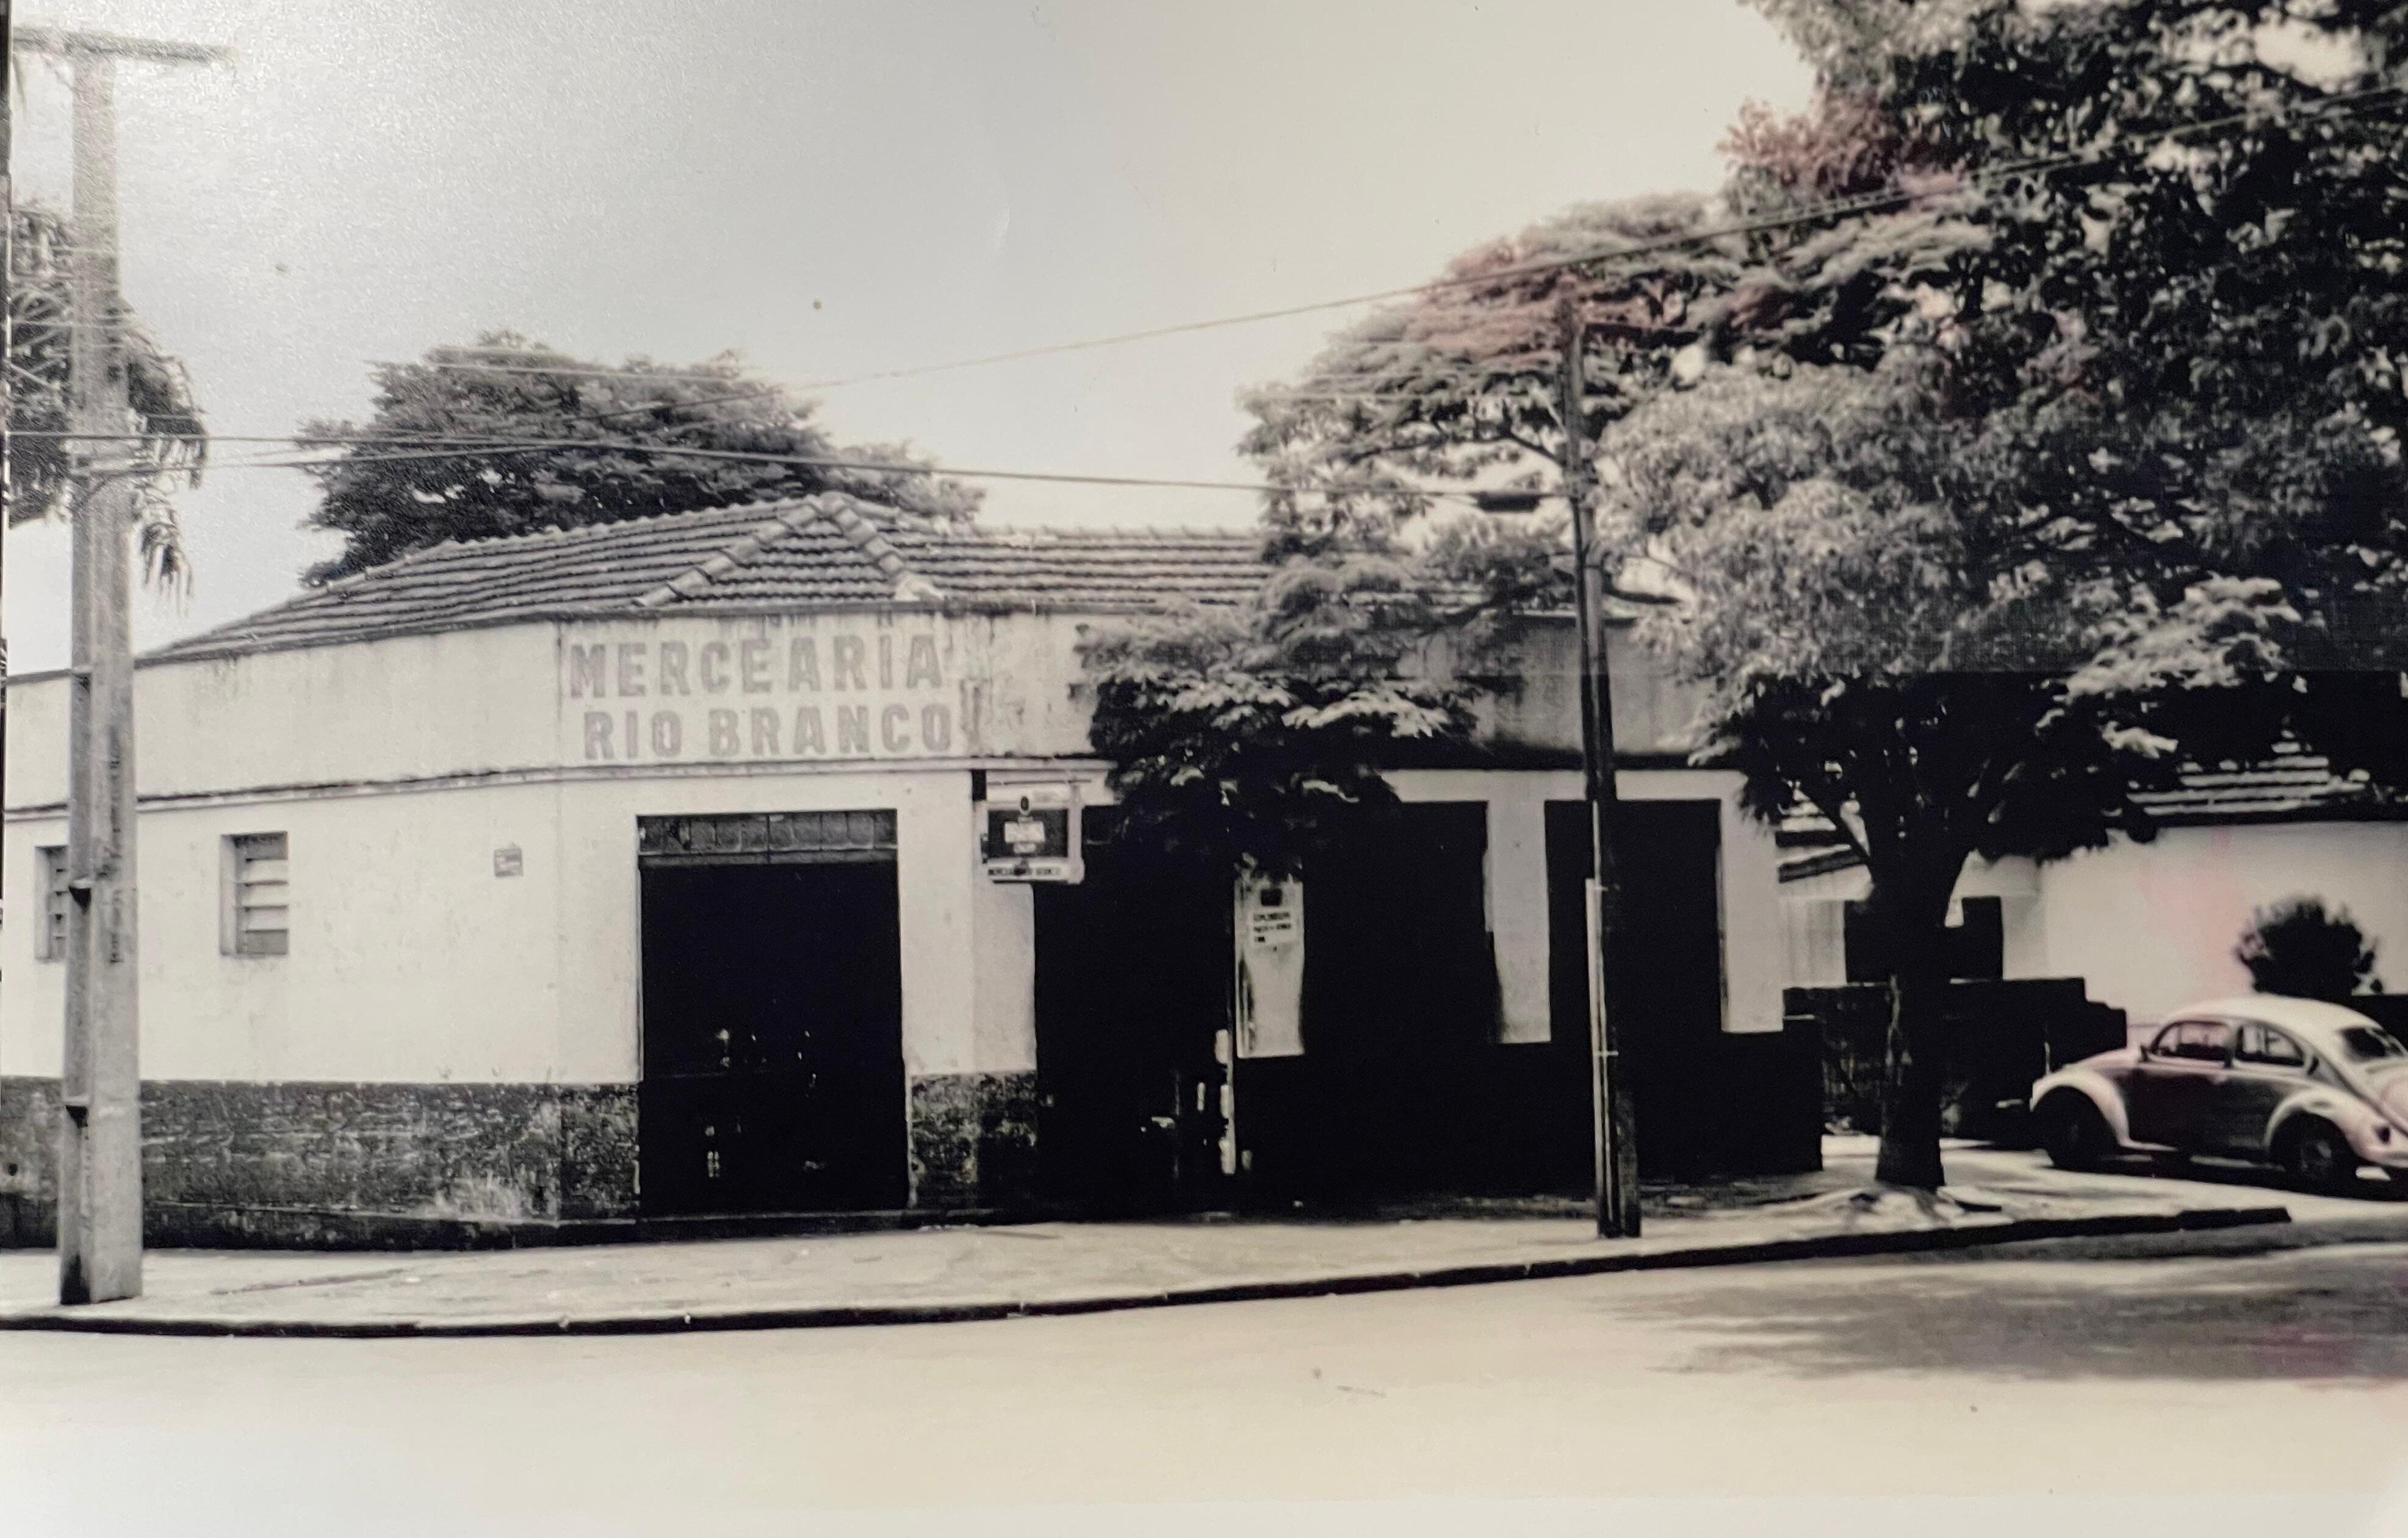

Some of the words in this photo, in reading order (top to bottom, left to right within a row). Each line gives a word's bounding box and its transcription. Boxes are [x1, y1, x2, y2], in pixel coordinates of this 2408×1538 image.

[569, 635, 943, 698] MERCEARIA
[583, 710, 683, 759] RIO
[708, 703, 952, 755] BRANCO
